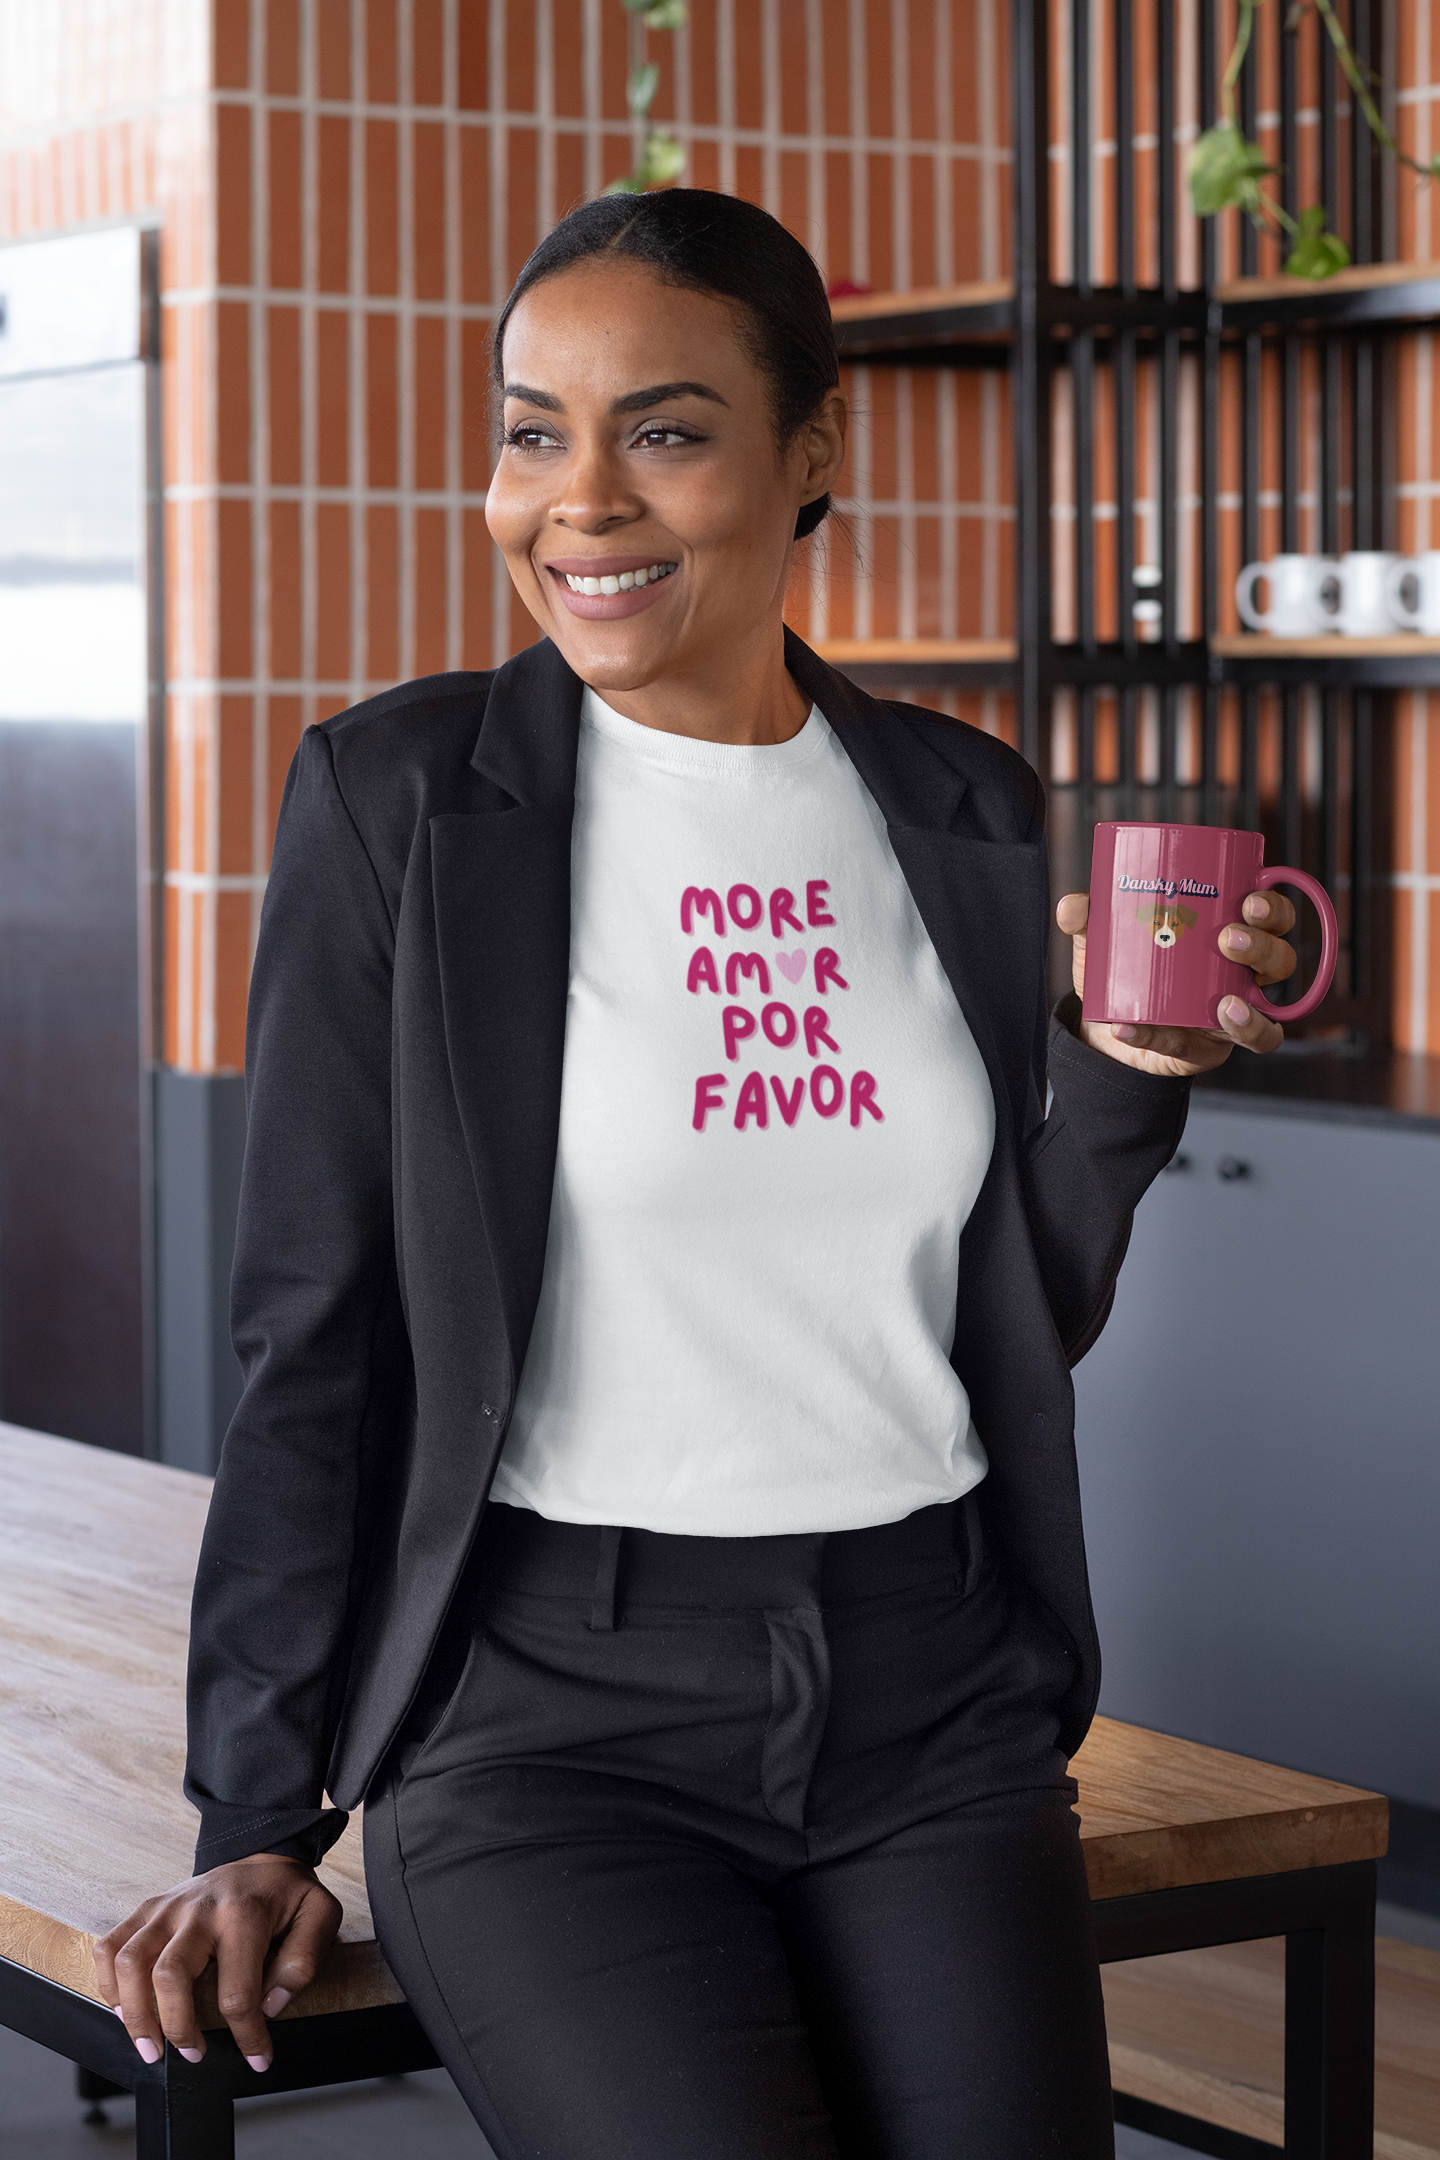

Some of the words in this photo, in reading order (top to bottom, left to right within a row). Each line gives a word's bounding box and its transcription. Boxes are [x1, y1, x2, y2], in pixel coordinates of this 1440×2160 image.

[680, 879, 836, 939] MORE
[1117, 874, 1177, 899] Dansky
[1178, 878, 1219, 899] Mum
[687, 946, 849, 997] AMR
[722, 1001, 842, 1063] POR
[692, 1064, 885, 1133] FAVOR
